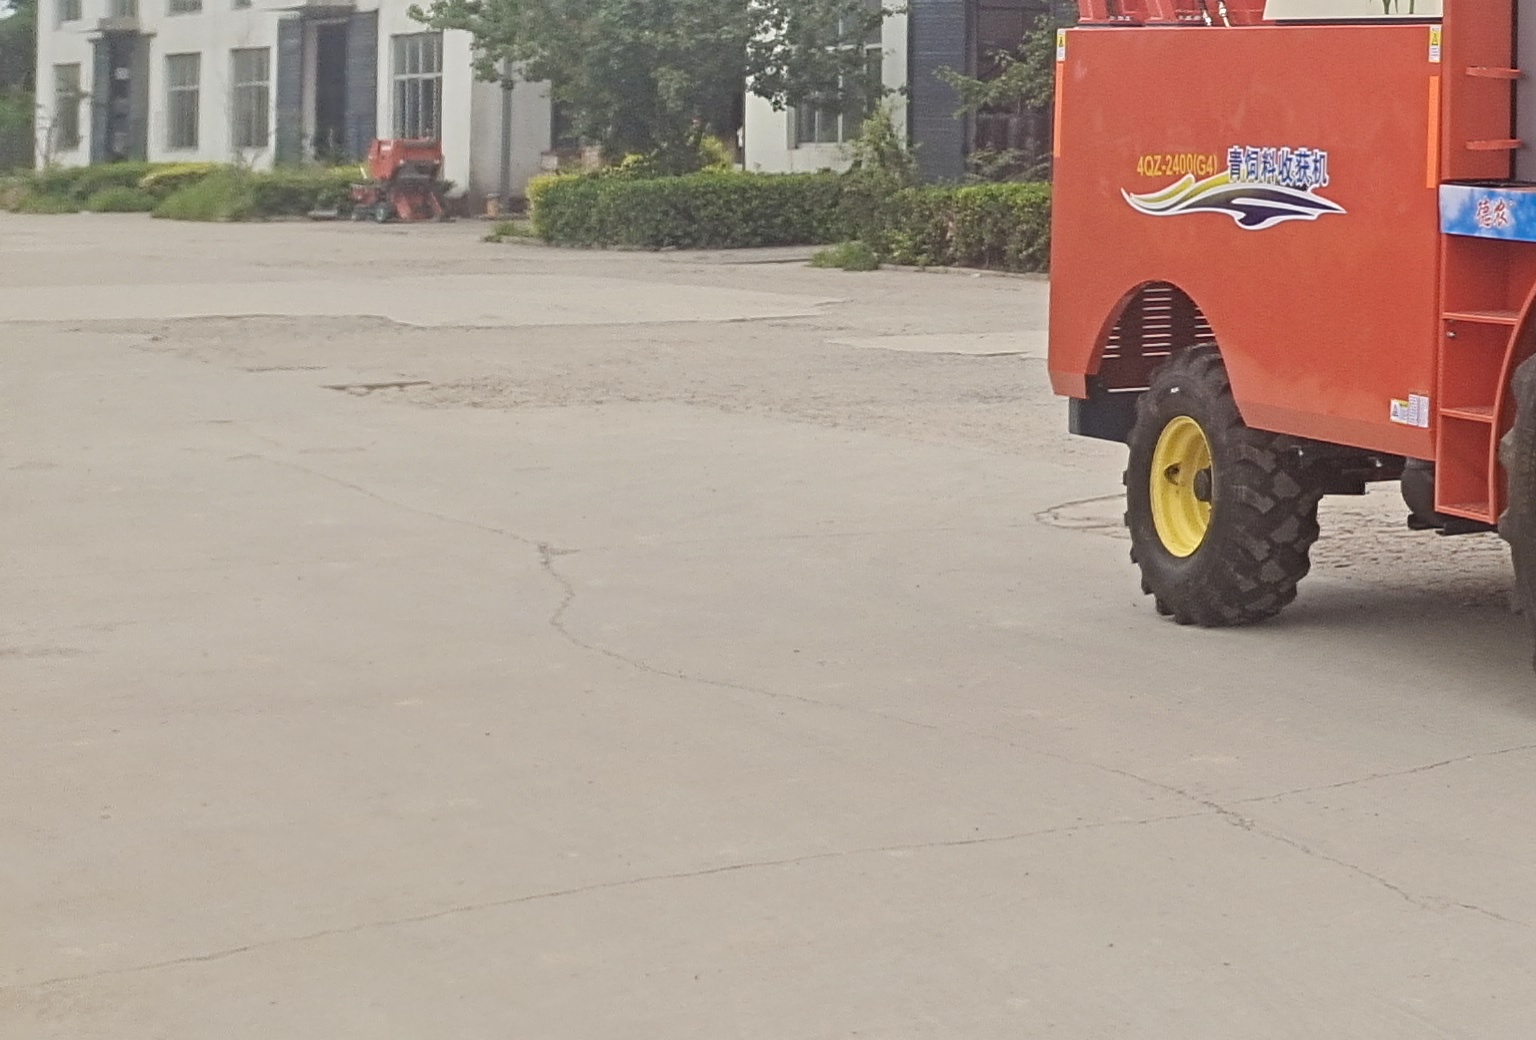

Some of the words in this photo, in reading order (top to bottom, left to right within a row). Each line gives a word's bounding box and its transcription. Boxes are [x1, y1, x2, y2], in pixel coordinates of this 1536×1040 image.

[1137, 154, 1218, 176] 4QZ-2400(G4)
[1228, 146, 1329, 186] 青饲料收获机
